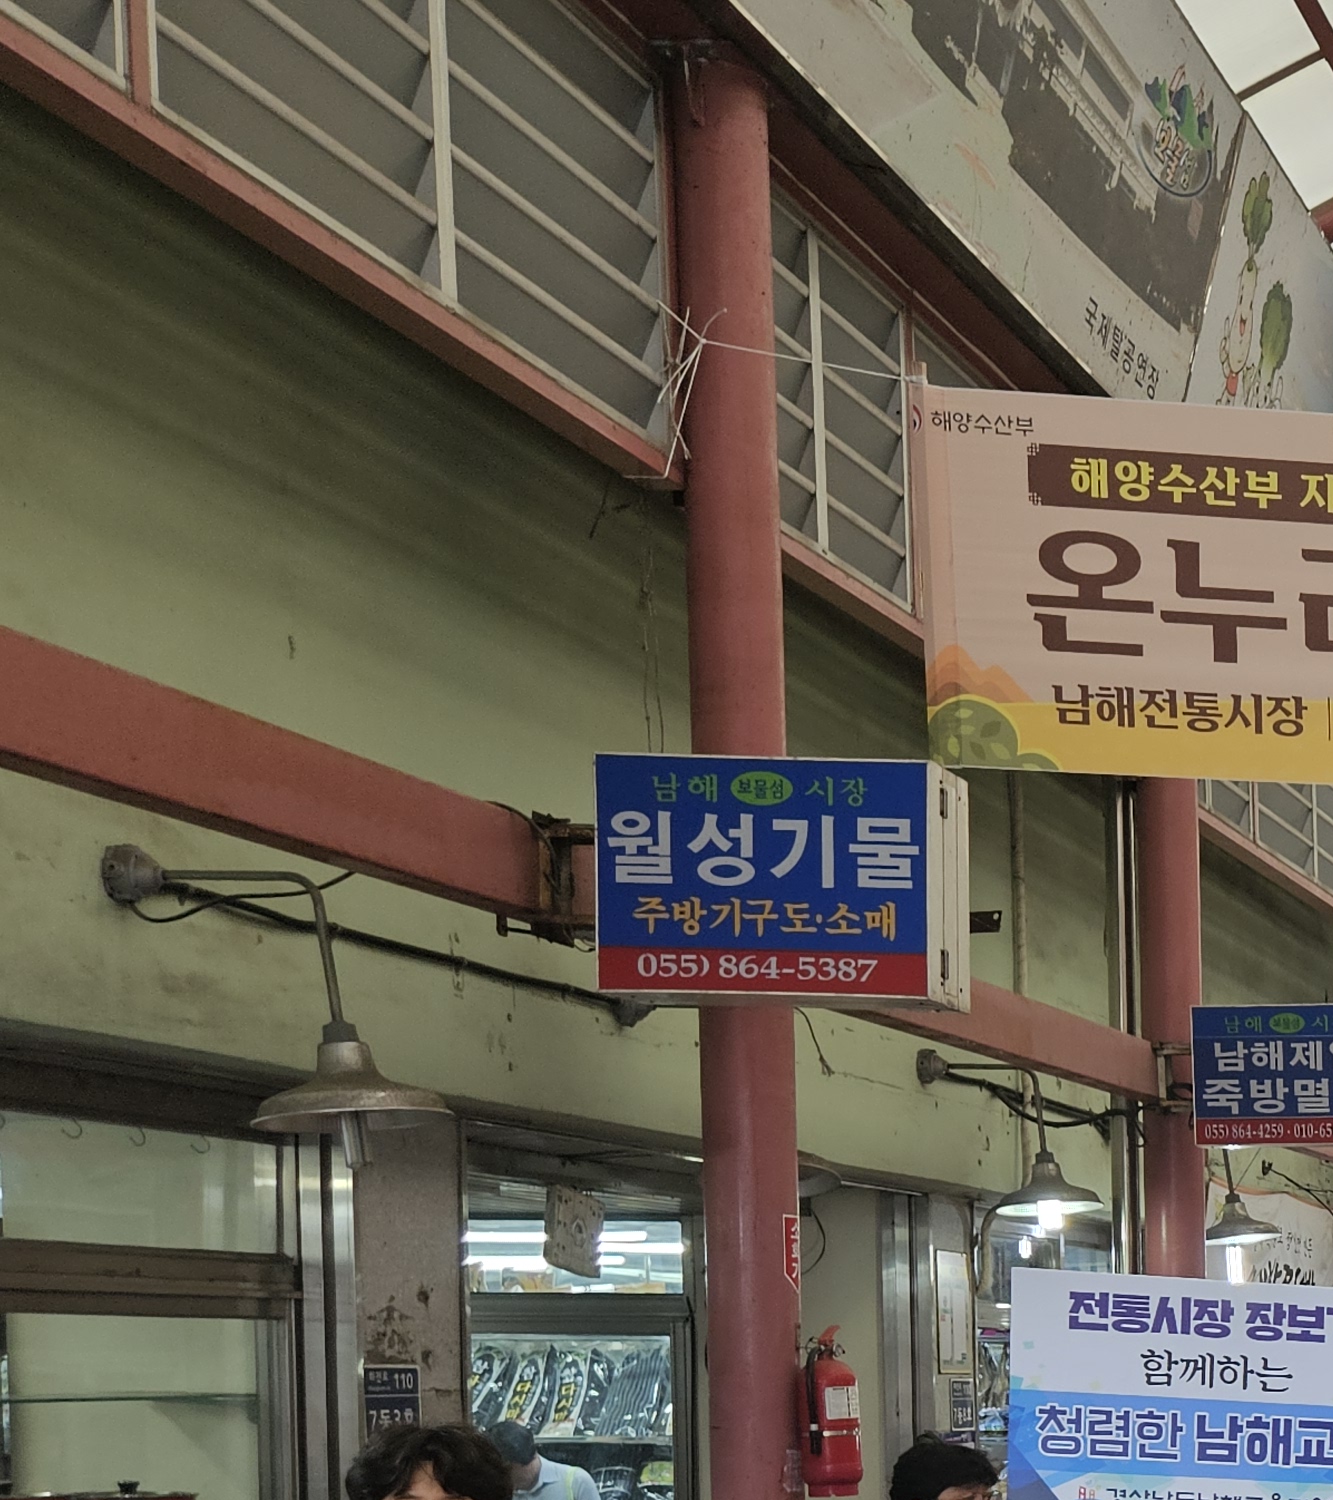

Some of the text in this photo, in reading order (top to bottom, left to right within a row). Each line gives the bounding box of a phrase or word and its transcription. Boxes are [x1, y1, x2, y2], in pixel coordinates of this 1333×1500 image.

[1082, 295, 1160, 401] 국제탈공연장
[930, 408, 1035, 437] 해양수산부
[1070, 457, 1283, 513] 해양수산부
[1051, 683, 1307, 738] 남해전통시장
[651, 771, 868, 807] 남해 보물섬 시장
[606, 809, 920, 890] 월성기물
[637, 952, 879, 984] 055) 864-5387
[1224, 1015, 1263, 1034] 남해
[1204, 1123, 1230, 1140] 055)
[1231, 1122, 1285, 1140] 864-4259
[1067, 1290, 1235, 1339] 전통시장
[393, 1372, 414, 1390] 110
[1139, 1348, 1295, 1394] 함께하는
[1034, 1402, 1187, 1463] 청렴한
